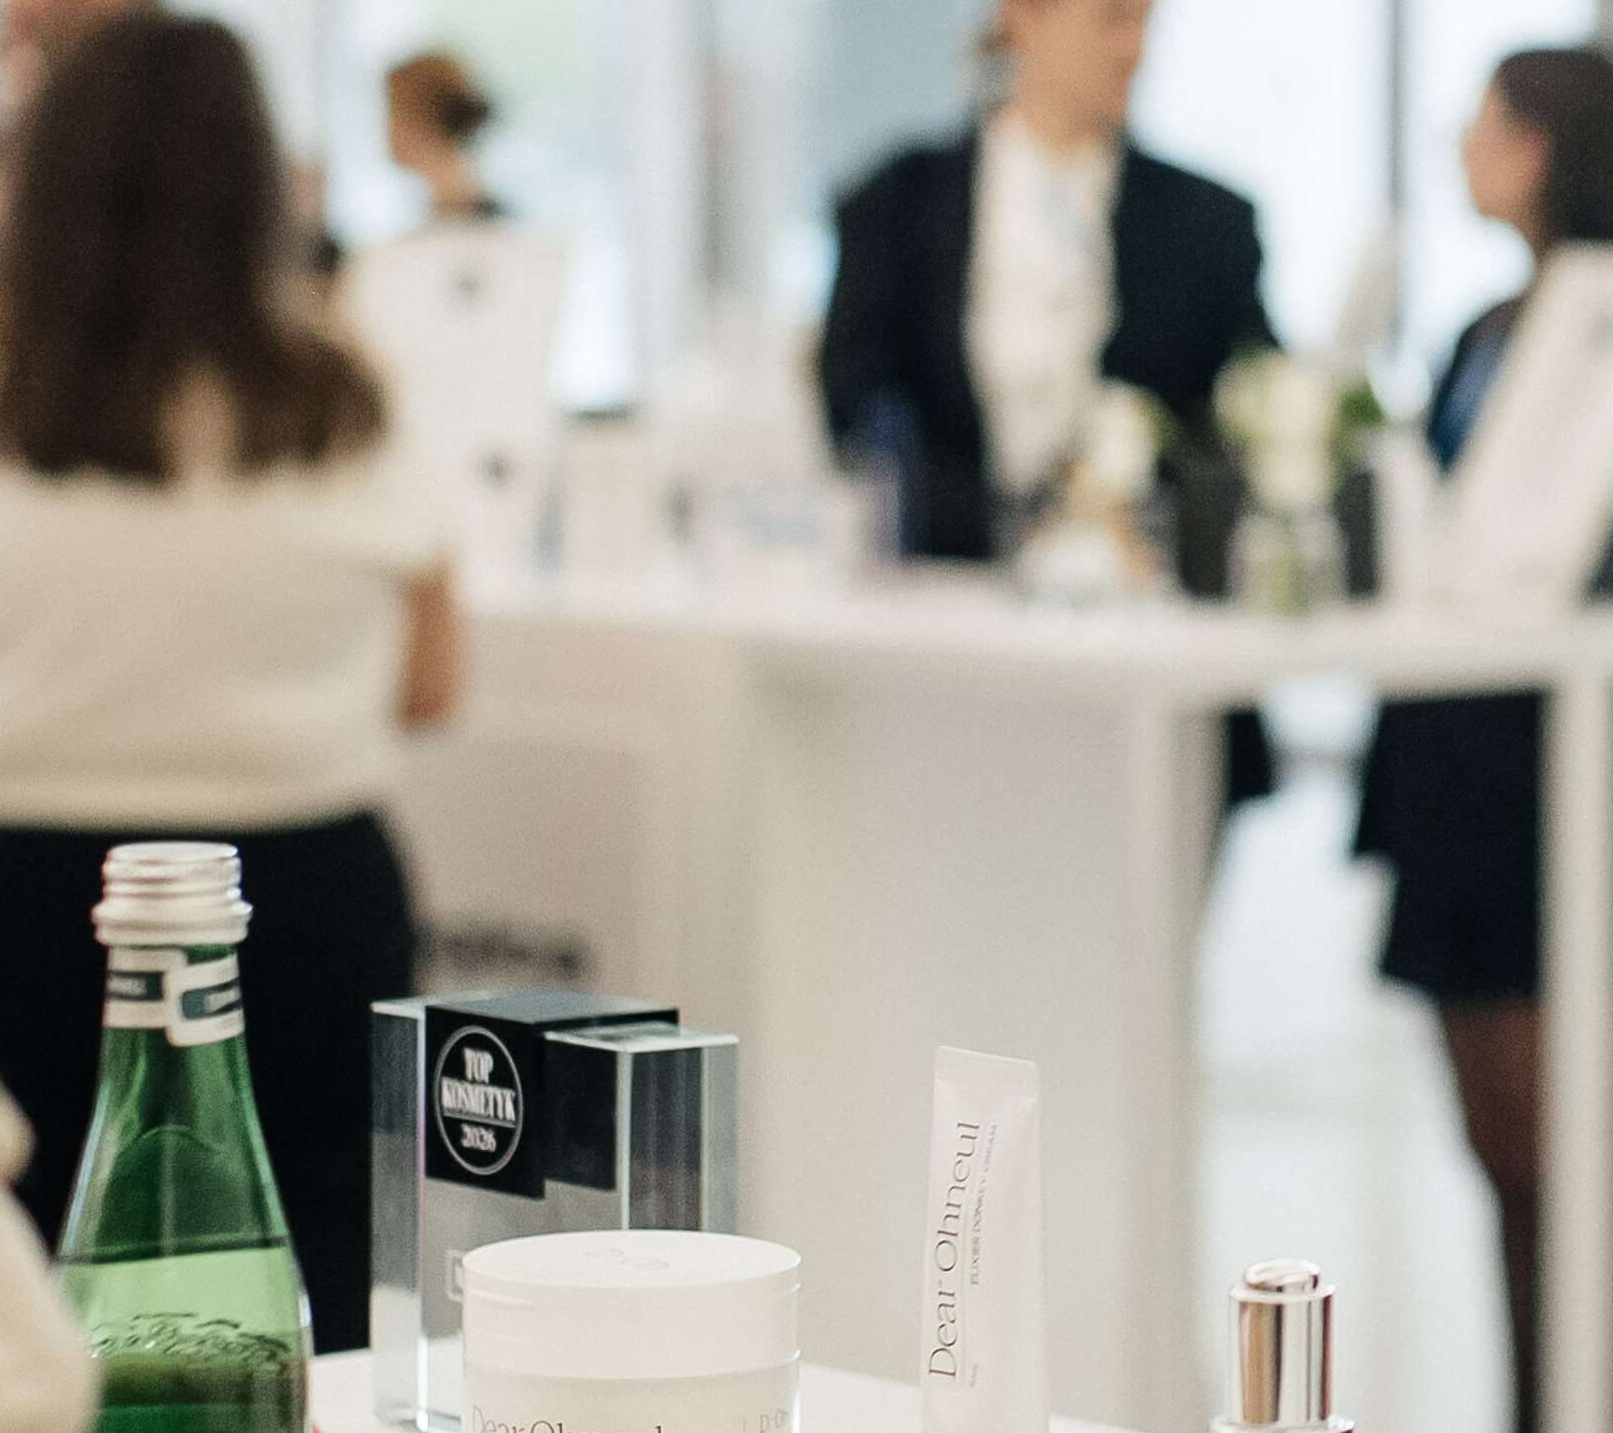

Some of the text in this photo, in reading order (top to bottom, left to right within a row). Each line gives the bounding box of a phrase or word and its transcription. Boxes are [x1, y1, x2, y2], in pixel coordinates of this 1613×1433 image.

[462, 1046, 495, 1084] TOP
[440, 1076, 516, 1122] KOSMETYK
[927, 1120, 981, 1381] Dear Ohneul
